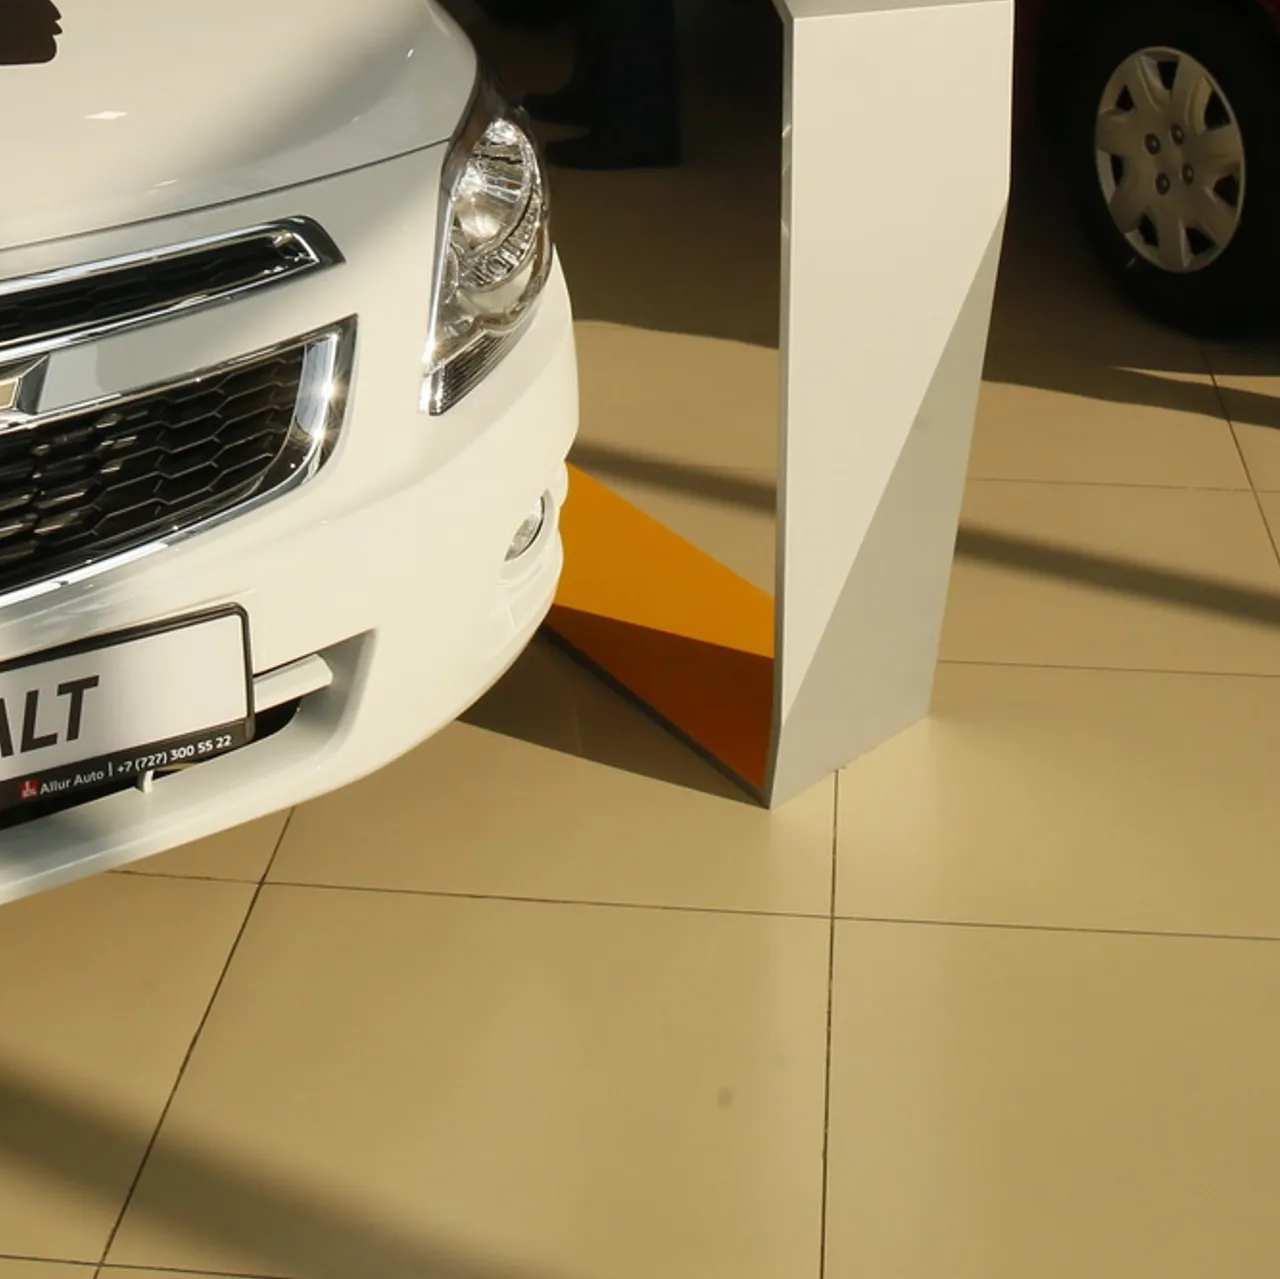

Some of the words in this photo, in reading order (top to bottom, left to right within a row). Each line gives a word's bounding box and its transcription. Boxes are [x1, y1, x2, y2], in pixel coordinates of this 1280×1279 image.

[39, 778, 70, 795] Allur
[72, 769, 104, 787] Auto
[117, 761, 133, 773] +7
[134, 753, 167, 771] (727)
[169, 744, 194, 762] 300
[197, 741, 213, 754] 55
[215, 734, 232, 748] 22
